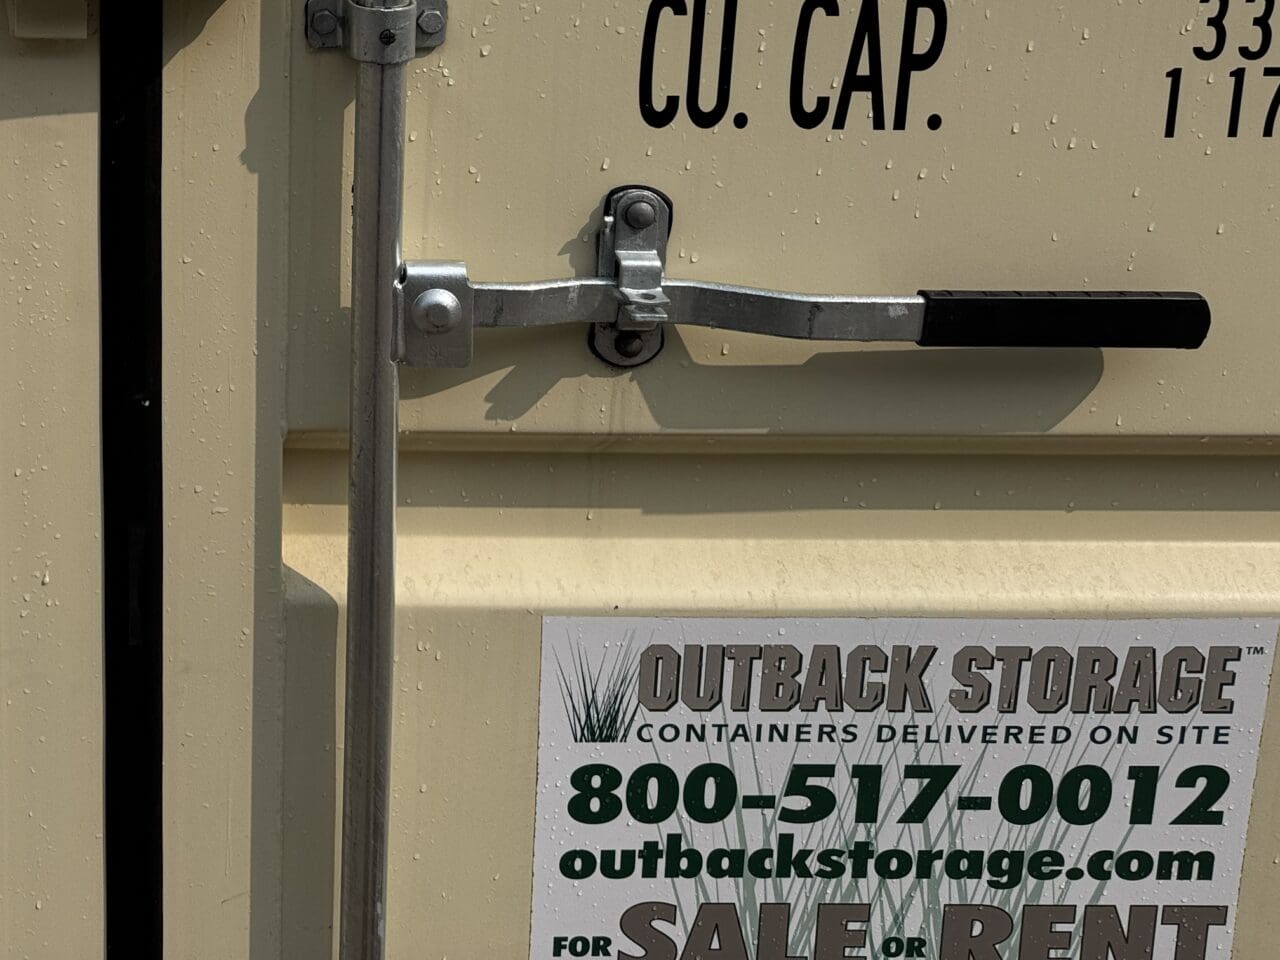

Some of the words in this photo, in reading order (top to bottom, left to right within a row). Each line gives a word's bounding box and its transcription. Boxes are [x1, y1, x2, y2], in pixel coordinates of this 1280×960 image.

[638, 644, 938, 712] OUTBACK
[949, 645, 1242, 714] STORAGE
[636, 723, 858, 743] CONTAINERS
[876, 725, 1072, 745] DELIVERED
[1089, 725, 1139, 745] ON
[1156, 725, 1231, 745] SITE
[567, 763, 1231, 826] 800-517-0012
[559, 833, 1215, 890] outbackstorage.com
[552, 936, 612, 957] FOR
[617, 901, 872, 960] SALE
[881, 936, 927, 958] OR
[938, 903, 1229, 960] RENT
